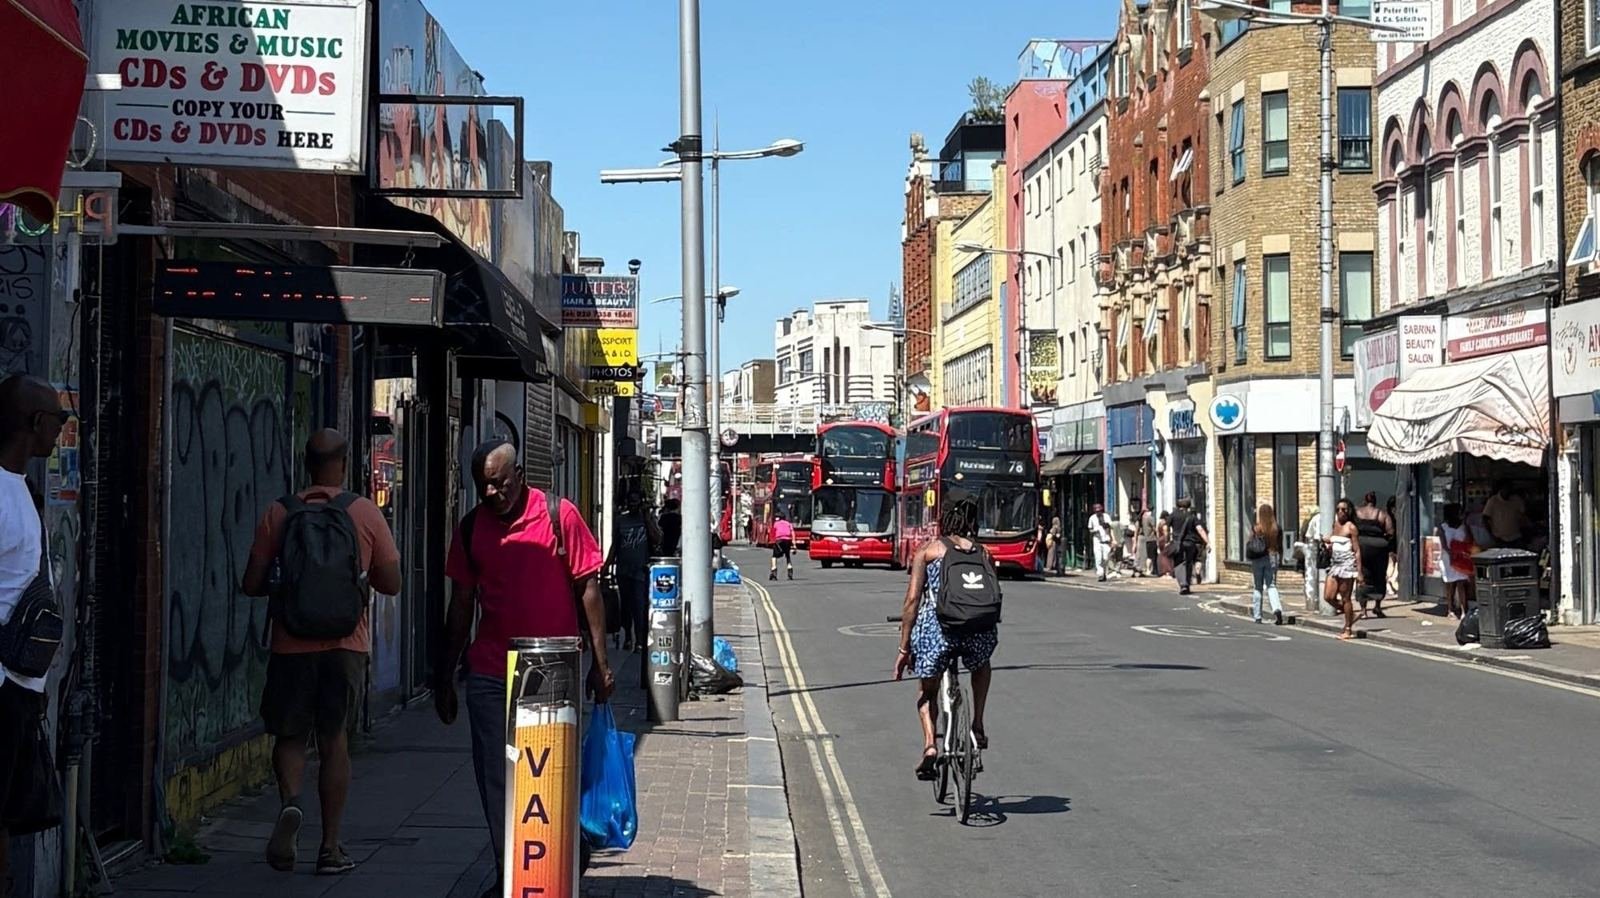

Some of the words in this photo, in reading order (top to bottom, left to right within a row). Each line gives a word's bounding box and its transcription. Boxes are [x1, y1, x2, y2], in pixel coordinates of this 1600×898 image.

[171, 4, 292, 30] AFRICAN
[116, 29, 219, 54] MOVIES
[229, 34, 249, 55] &
[257, 35, 343, 59] MUSIC
[118, 58, 187, 90] CDs
[200, 61, 228, 91] &
[240, 62, 336, 96] DVDs
[172, 99, 225, 118] COPY
[230, 102, 285, 120] YOUR
[113, 118, 162, 143] CDs
[171, 121, 190, 143] &
[199, 122, 266, 146] DVDs
[277, 131, 334, 149] HERE
[595, 298, 631, 306] BEAUTY
[1404, 325, 1436, 335] SABRINA
[592, 337, 632, 345] PASSPORT
[1406, 340, 1435, 350] BEAUTY
[1408, 353, 1434, 363] SALON
[592, 367, 632, 377] PHOTOS
[594, 385, 629, 395] studio
